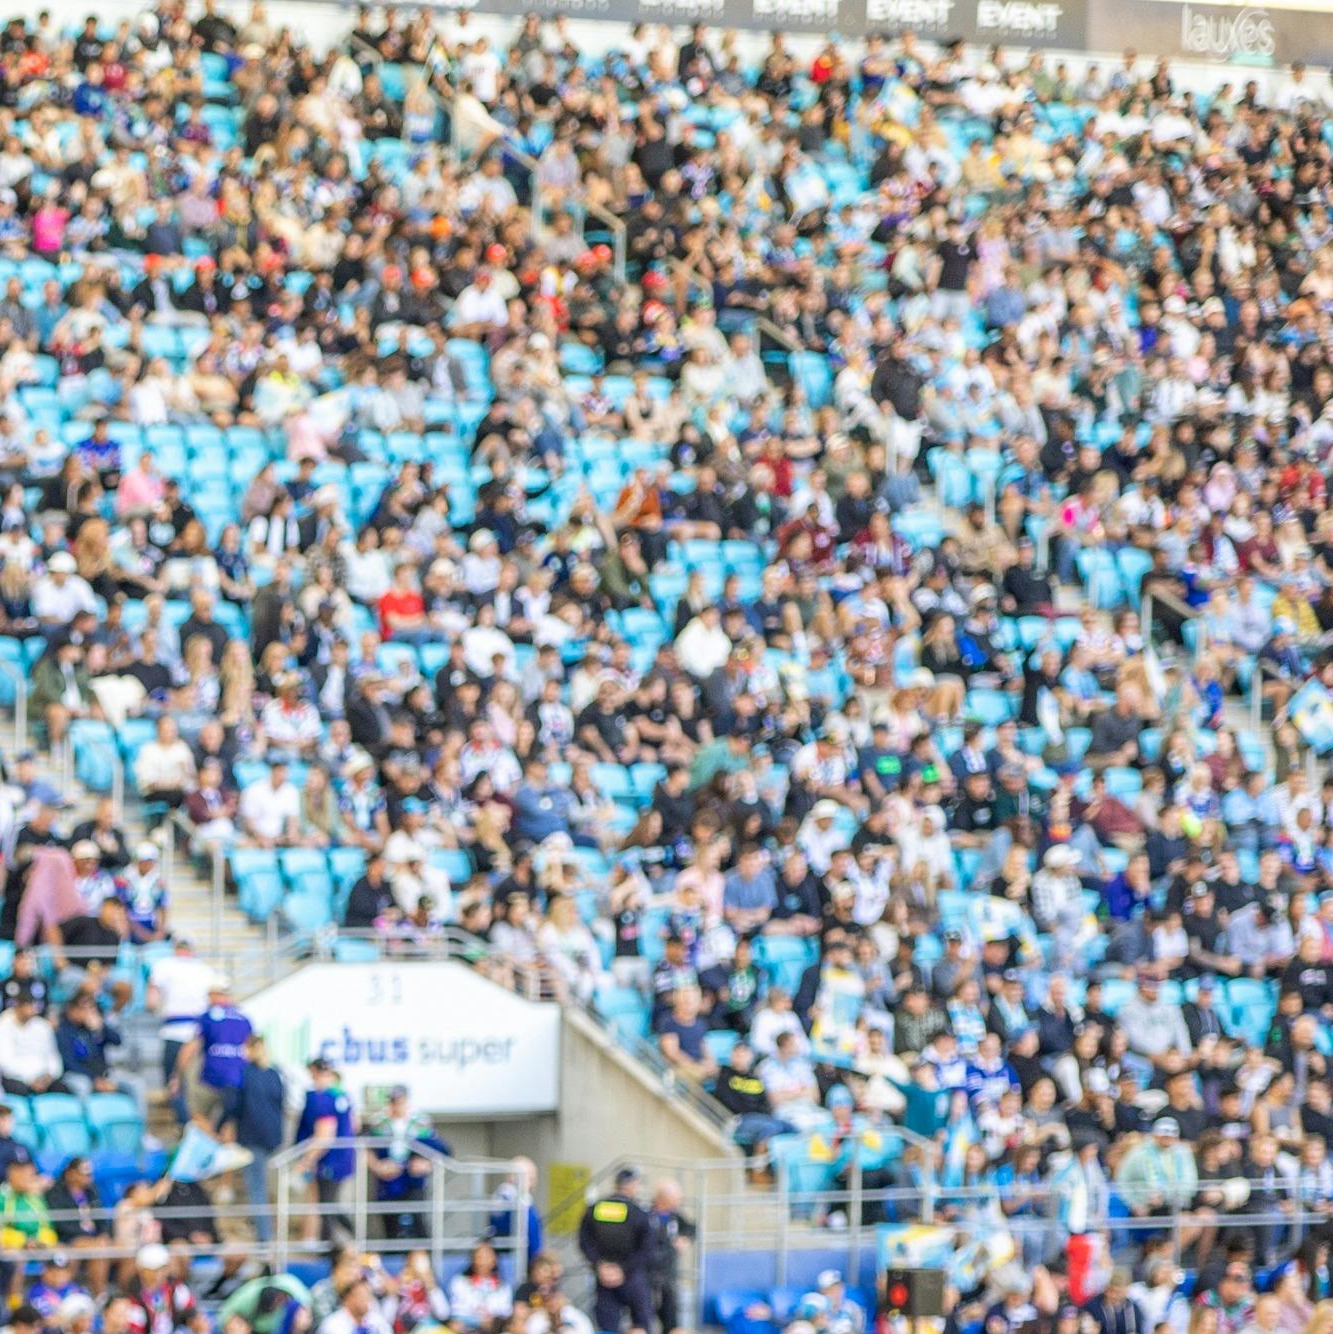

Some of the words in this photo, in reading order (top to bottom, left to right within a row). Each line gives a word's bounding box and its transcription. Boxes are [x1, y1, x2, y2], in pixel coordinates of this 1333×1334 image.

[977, 1, 1064, 30] EVENT
[319, 1025, 410, 1064] cbus
[419, 1036, 515, 1070] super
